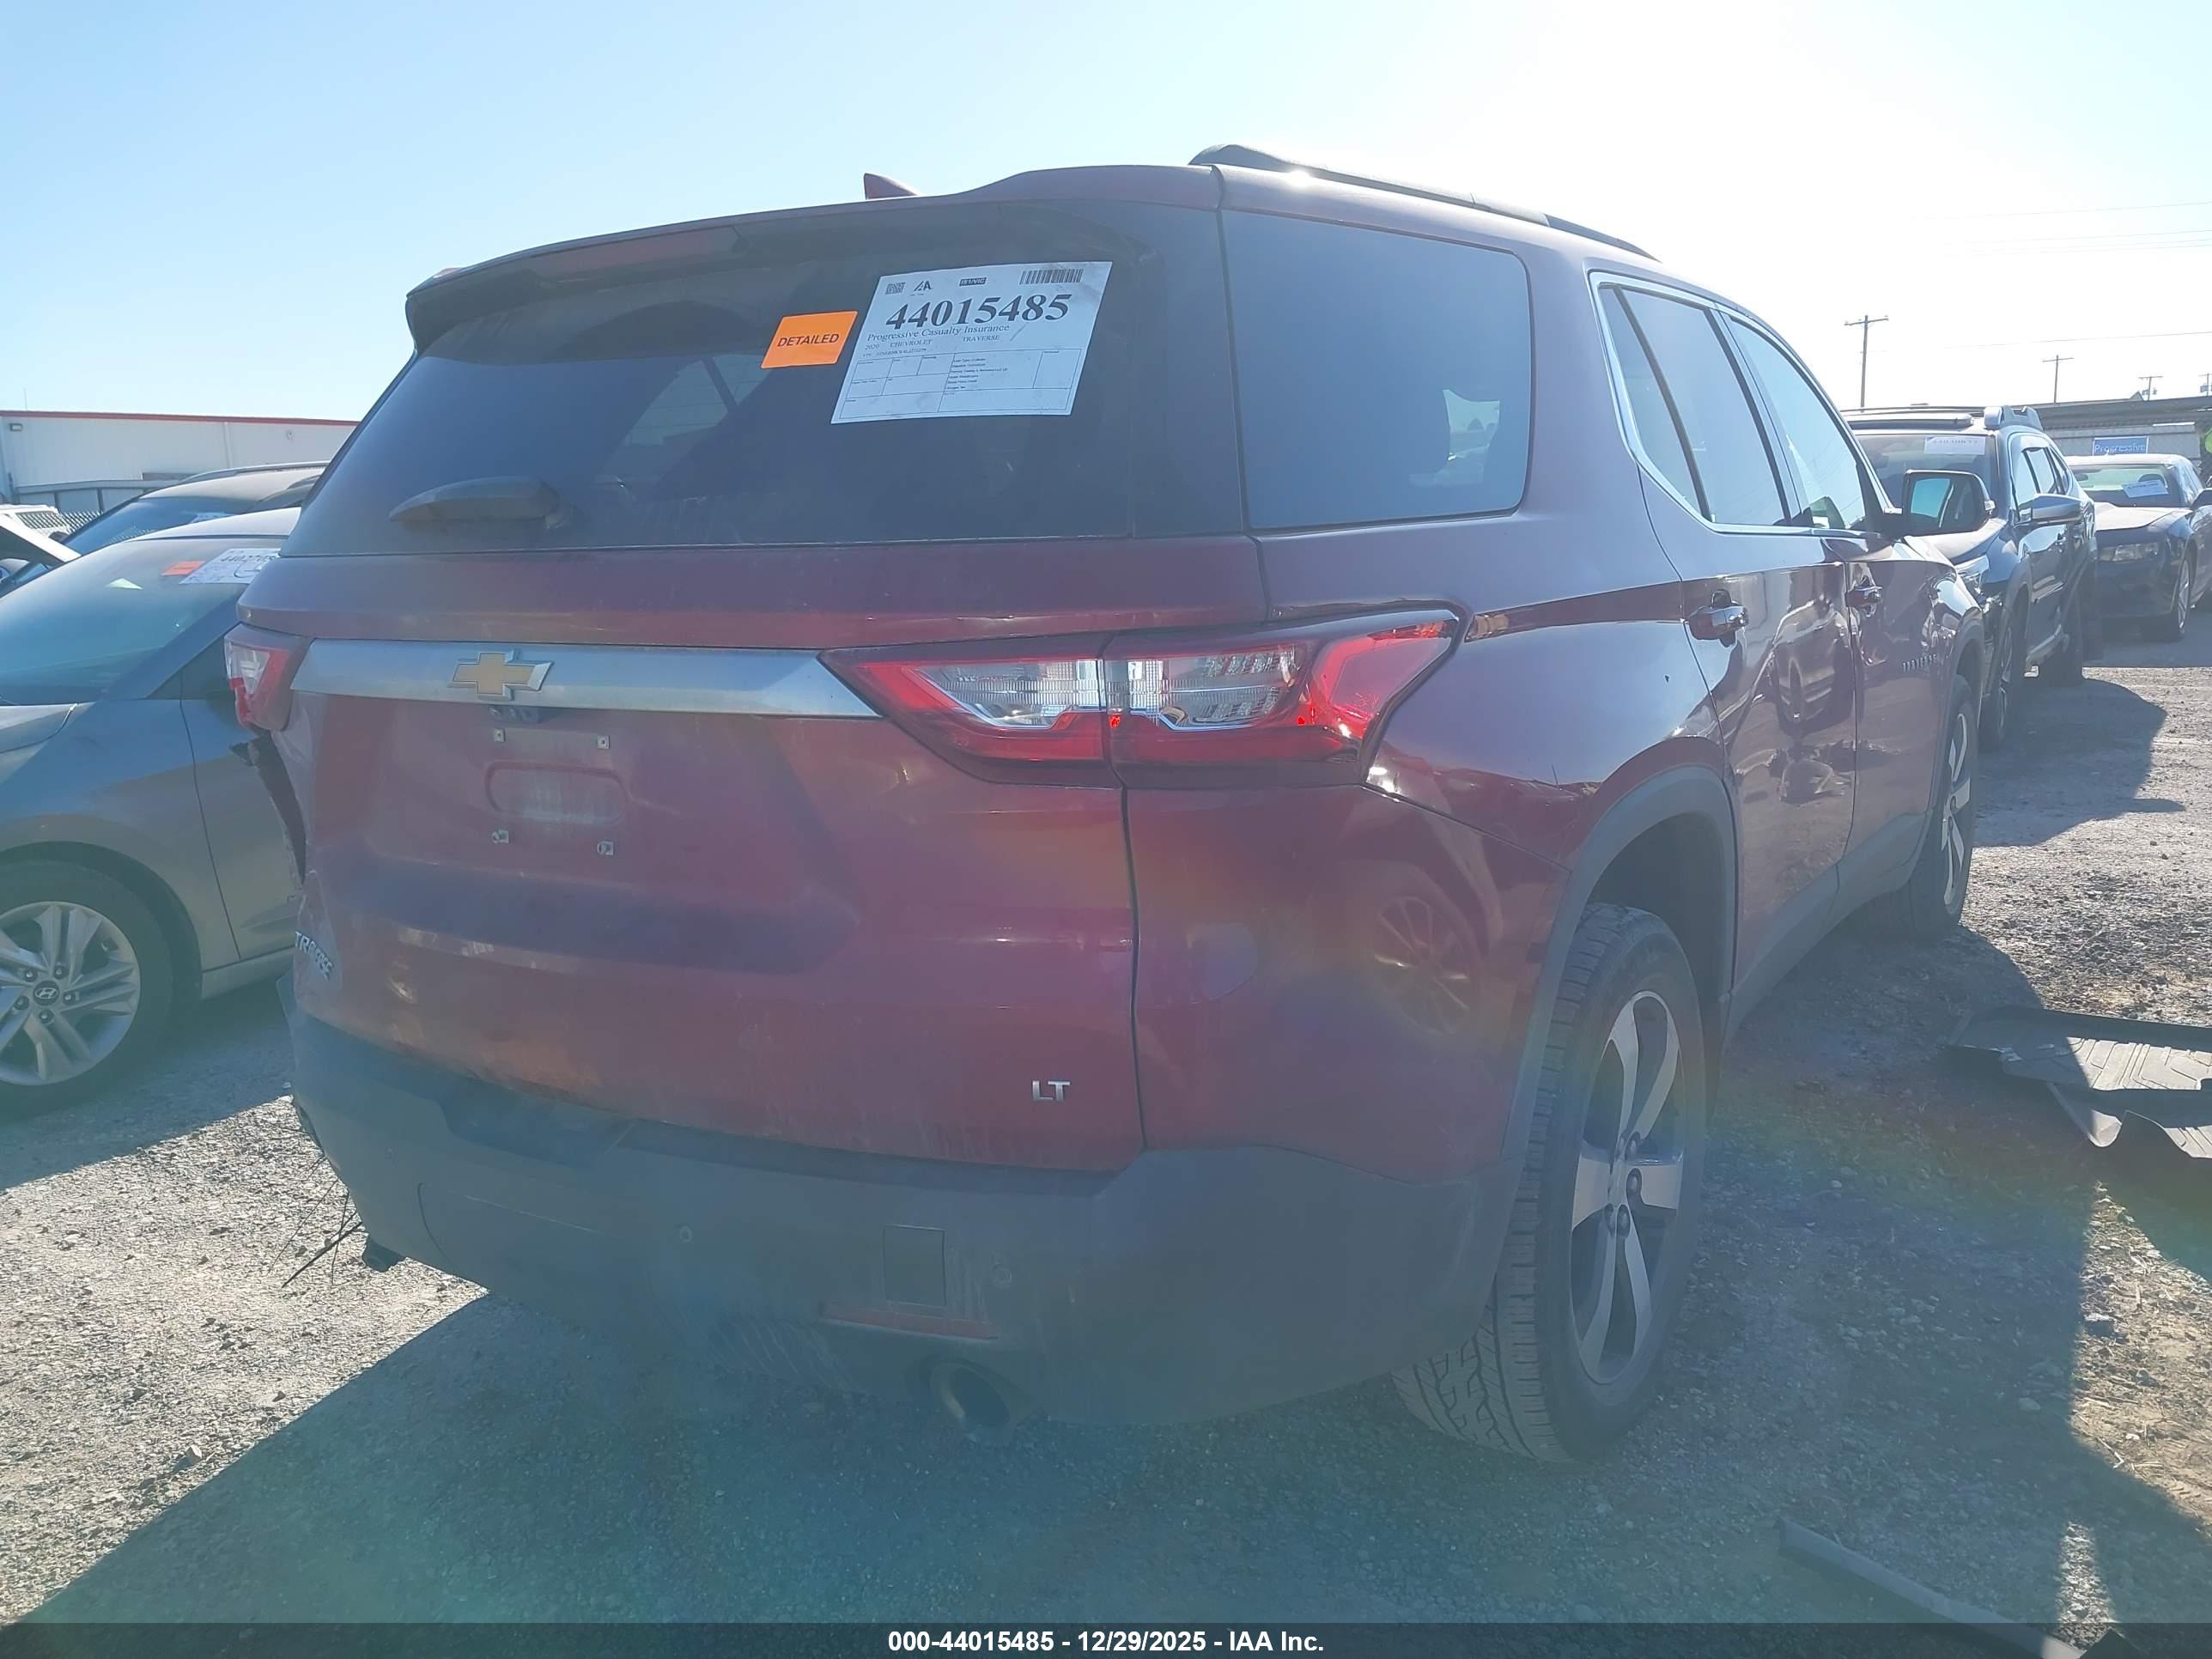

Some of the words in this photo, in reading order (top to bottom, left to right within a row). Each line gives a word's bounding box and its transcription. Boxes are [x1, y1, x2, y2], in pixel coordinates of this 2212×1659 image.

[886, 294, 1072, 330] 44015485
[777, 333, 839, 347] DETAILED
[867, 331, 920, 342] Progressive
[921, 326, 962, 337] Casualty
[964, 325, 1010, 333] Insurance
[890, 338, 933, 348] CHEVROLET
[2095, 443, 2146, 453] Progressive
[1032, 1080, 1071, 1101] LT
